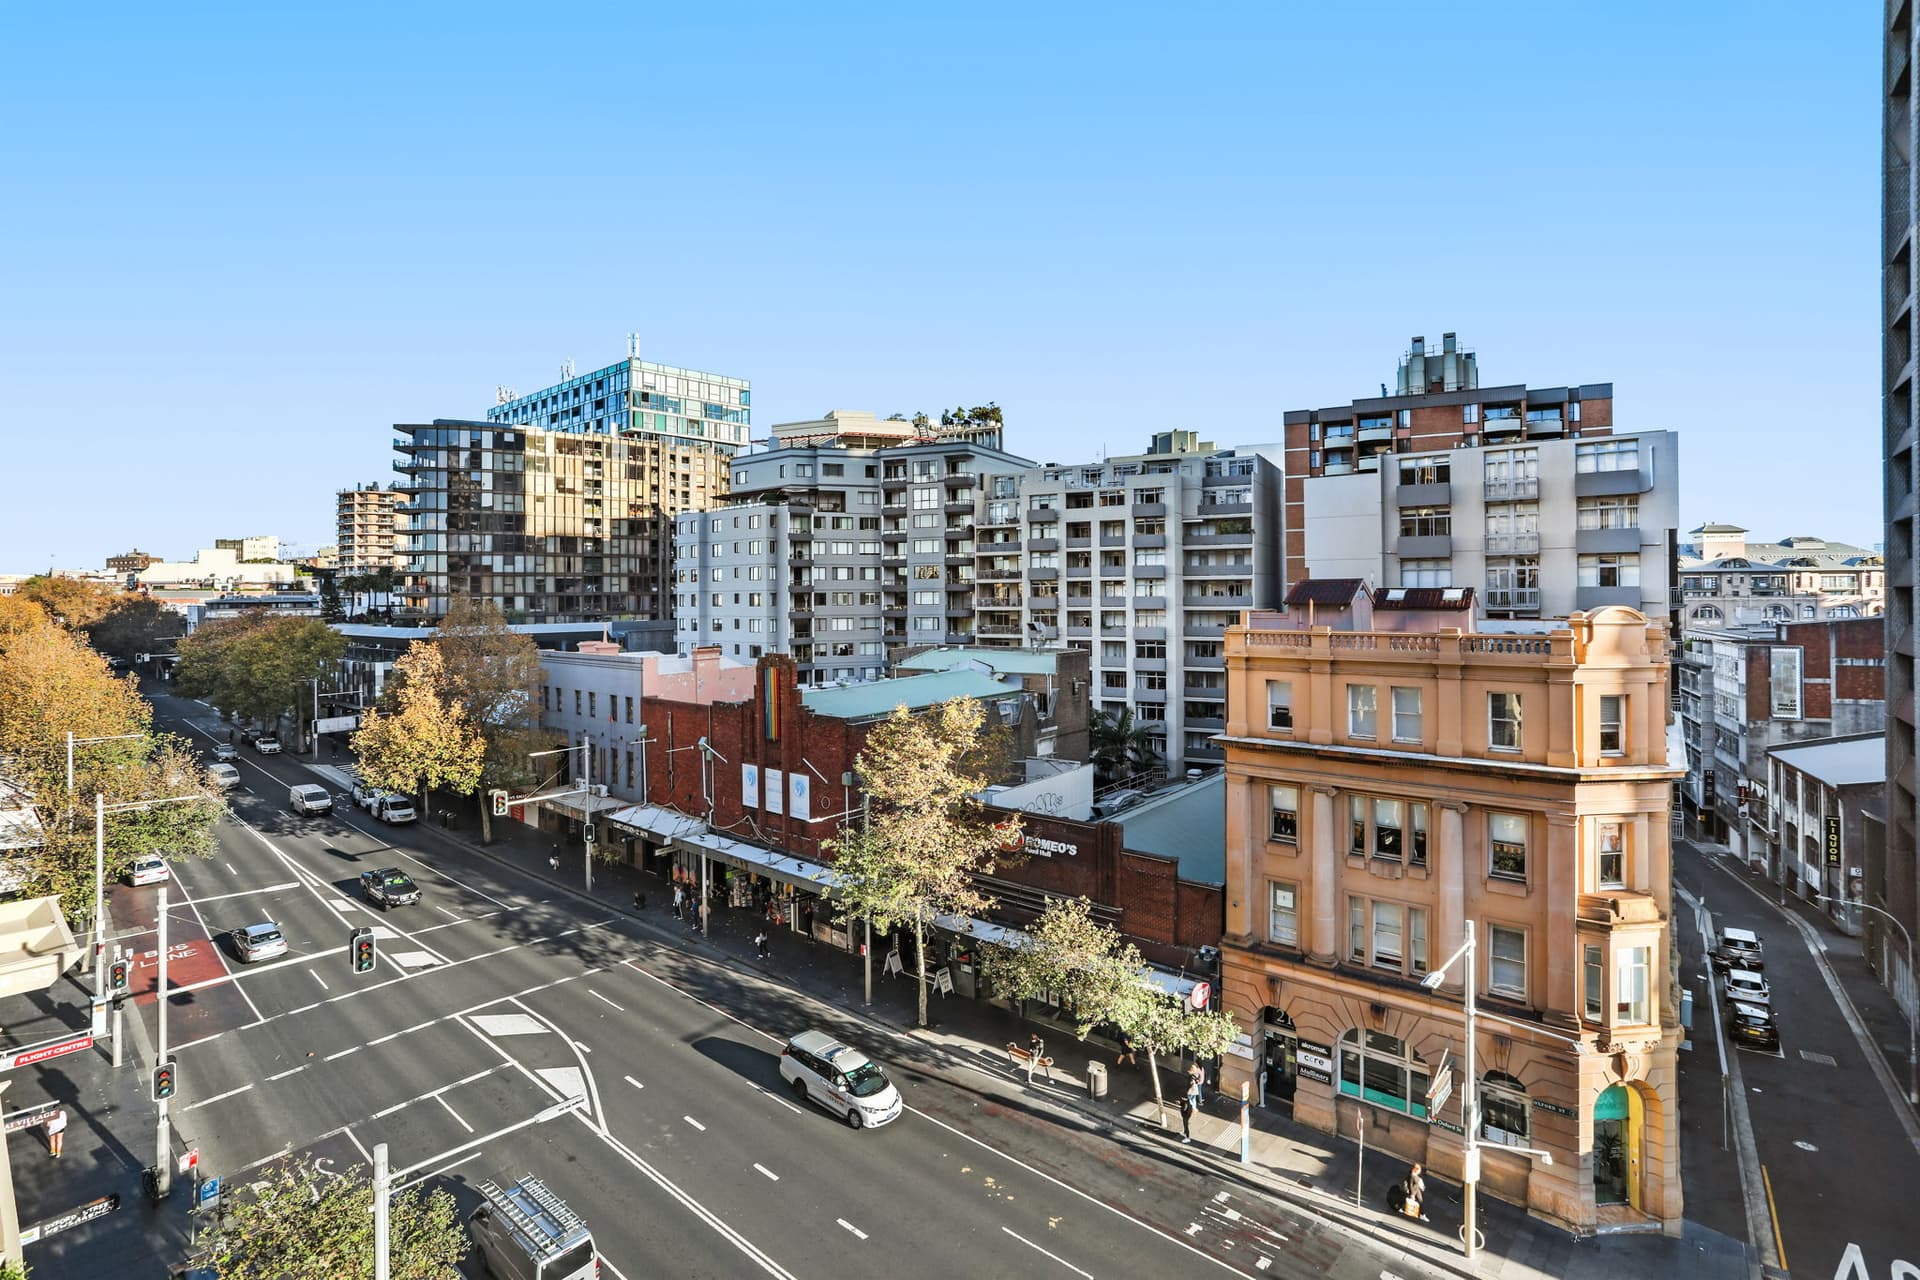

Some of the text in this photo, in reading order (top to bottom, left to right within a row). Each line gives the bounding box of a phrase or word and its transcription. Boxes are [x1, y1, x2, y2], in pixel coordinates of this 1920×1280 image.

[1025, 835, 1078, 857] ROMEO'S
[1828, 820, 1838, 862] LIQUOR
[139, 948, 198, 968] LNE
[18, 1040, 88, 1063] FLIGHT CENTRE
[1437, 1119, 1456, 1130] Oxford
